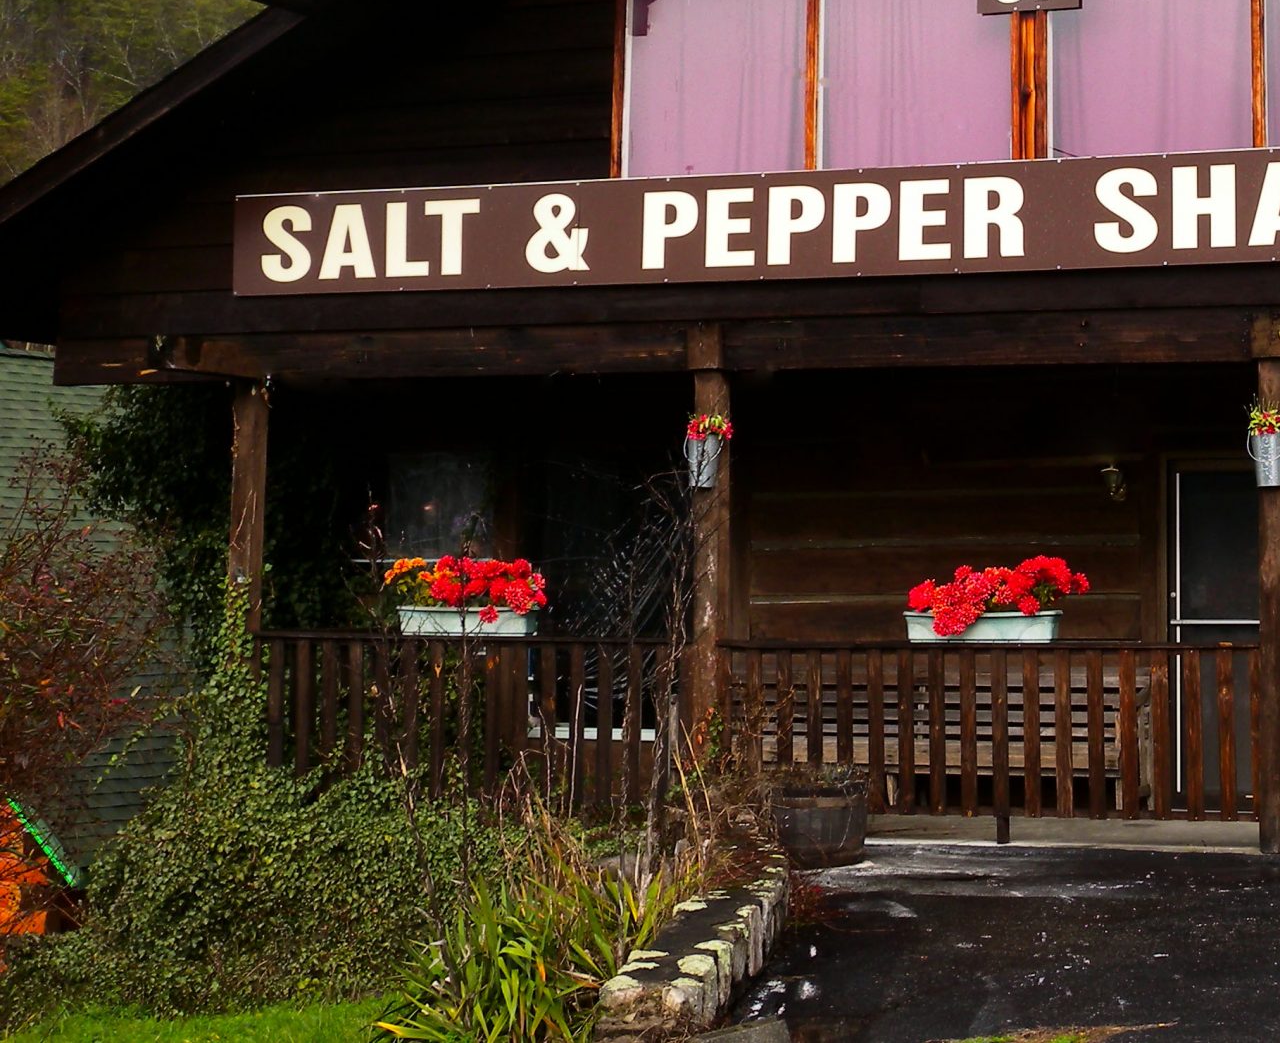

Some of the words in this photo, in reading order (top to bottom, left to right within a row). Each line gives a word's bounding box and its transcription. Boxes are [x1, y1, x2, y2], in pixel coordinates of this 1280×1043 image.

[261, 198, 480, 282] SALT
[525, 193, 590, 273] &
[642, 176, 1025, 270] PEPPER
